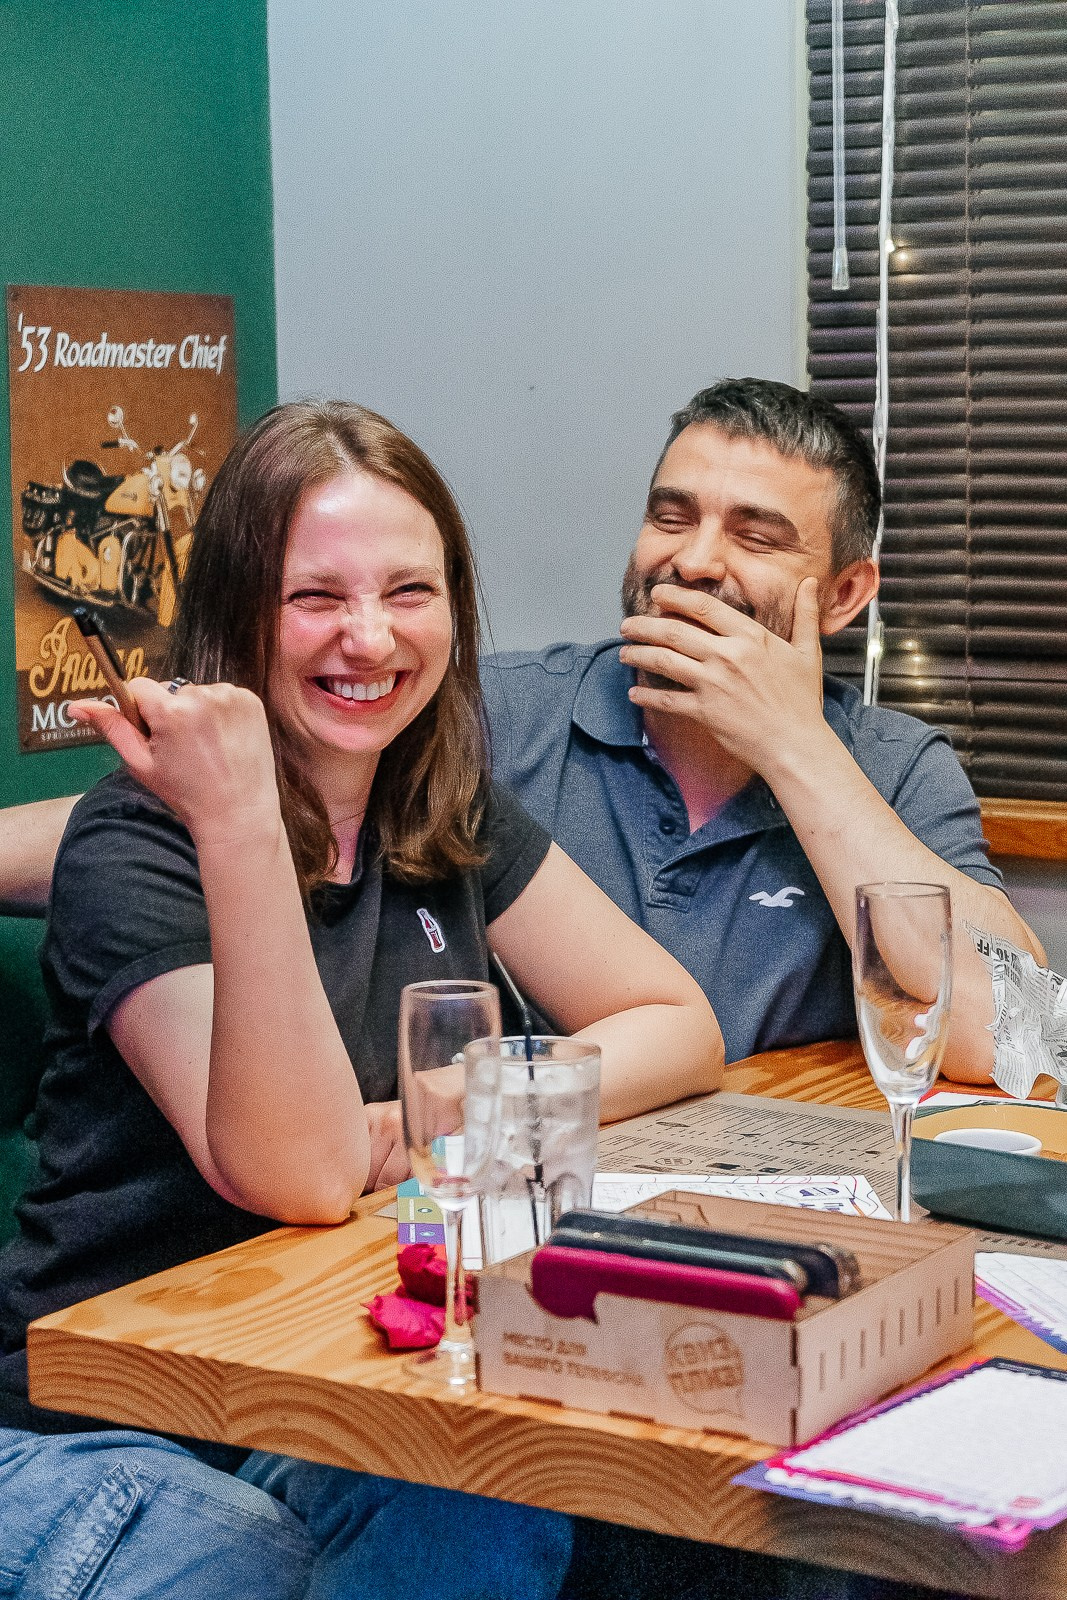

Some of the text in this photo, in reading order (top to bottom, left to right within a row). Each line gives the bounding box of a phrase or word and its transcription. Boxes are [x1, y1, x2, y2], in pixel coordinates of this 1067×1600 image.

[17, 312, 228, 376] '53 Roadmaster Chief
